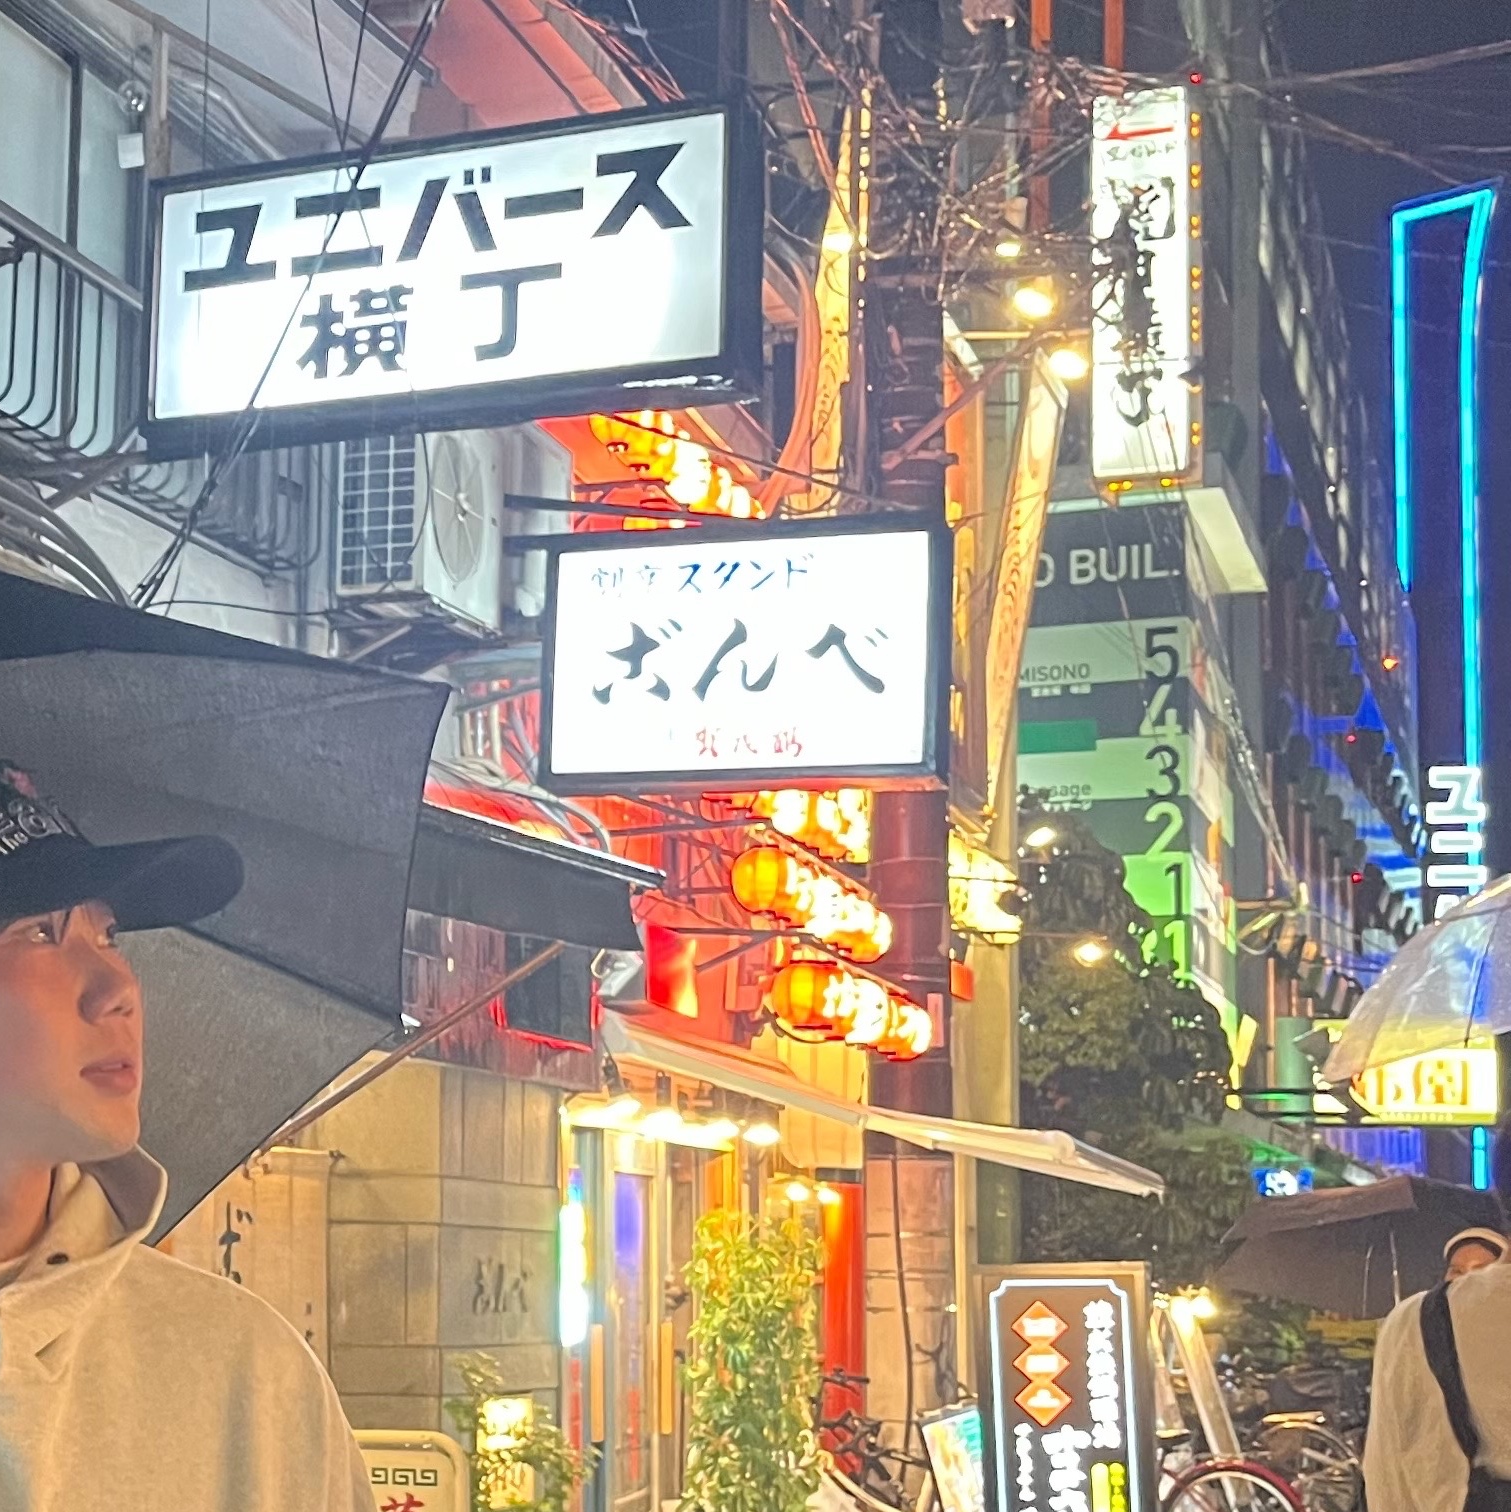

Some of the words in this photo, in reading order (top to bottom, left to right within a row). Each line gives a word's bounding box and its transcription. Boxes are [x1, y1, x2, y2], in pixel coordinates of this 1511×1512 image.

[183, 141, 694, 294] ユニバース
[295, 262, 565, 380] 横丁
[1144, 626, 1180, 685] 5
[1139, 684, 1182, 738] 4
[1144, 744, 1181, 800] 3
[1144, 801, 1184, 857] 2
[1164, 863, 1184, 916] 1
